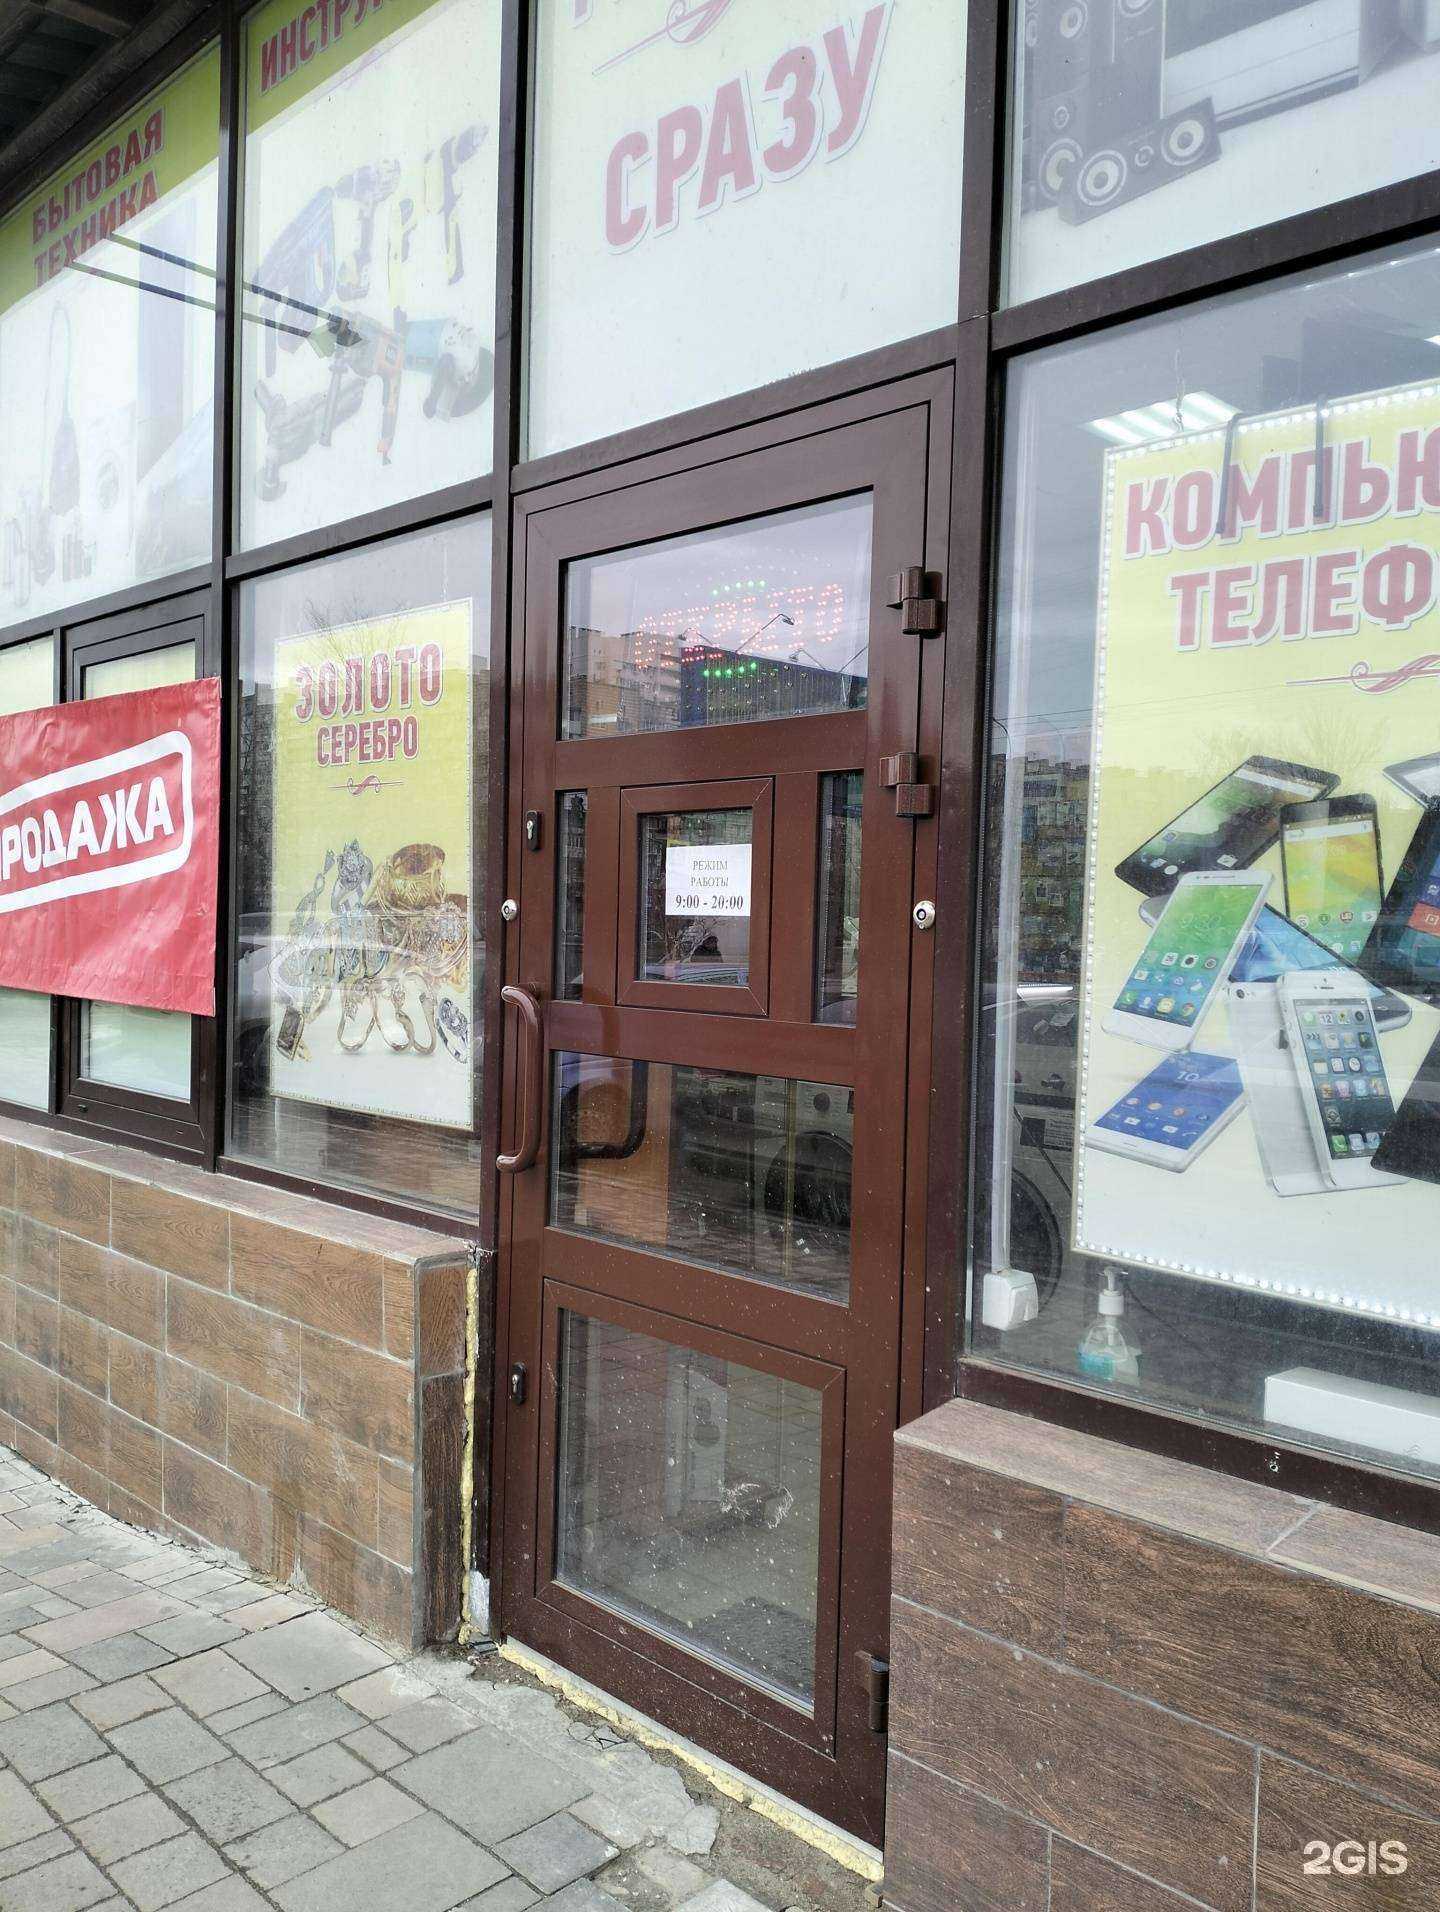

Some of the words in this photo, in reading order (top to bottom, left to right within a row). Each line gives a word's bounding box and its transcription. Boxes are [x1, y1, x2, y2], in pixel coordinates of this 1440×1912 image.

[604, 2, 892, 252] СРАЗУ
[32, 109, 164, 246] БЫТОВАЯ
[33, 170, 160, 288] ТЕХНИКА
[294, 642, 443, 721] ЗОЛОТО
[316, 714, 419, 767] СЕРЕБРО
[0, 776, 175, 882] РОДАЖА
[692, 859, 729, 872] РЕЖИМ
[675, 894, 700, 909] 9:00
[711, 895, 744, 910] 20:00
[690, 876, 729, 888] РАБОТЫ
